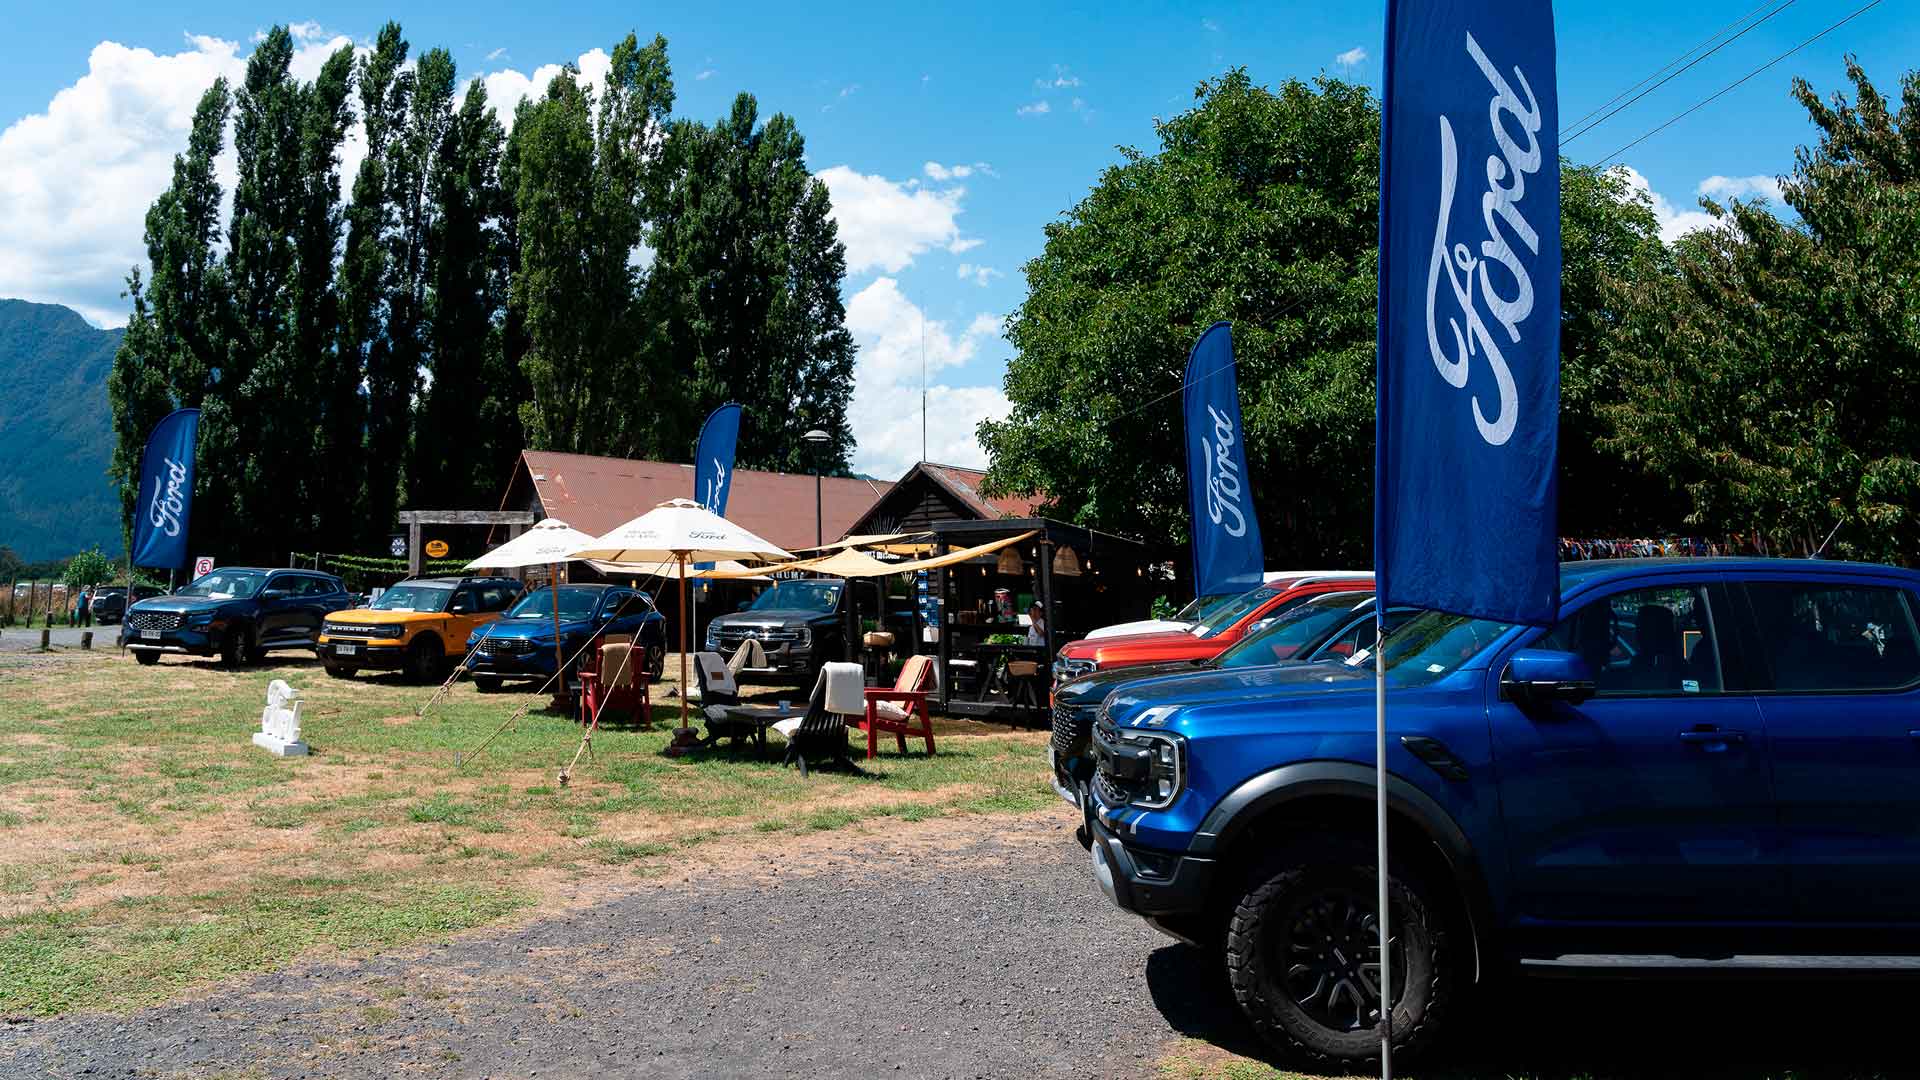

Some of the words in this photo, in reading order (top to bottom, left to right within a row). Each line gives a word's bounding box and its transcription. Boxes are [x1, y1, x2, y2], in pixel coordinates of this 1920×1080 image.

[1426, 31, 1542, 445] Ford
[150, 458, 187, 537] Ford
[1203, 404, 1246, 537] Ford
[688, 531, 728, 541] Ford
